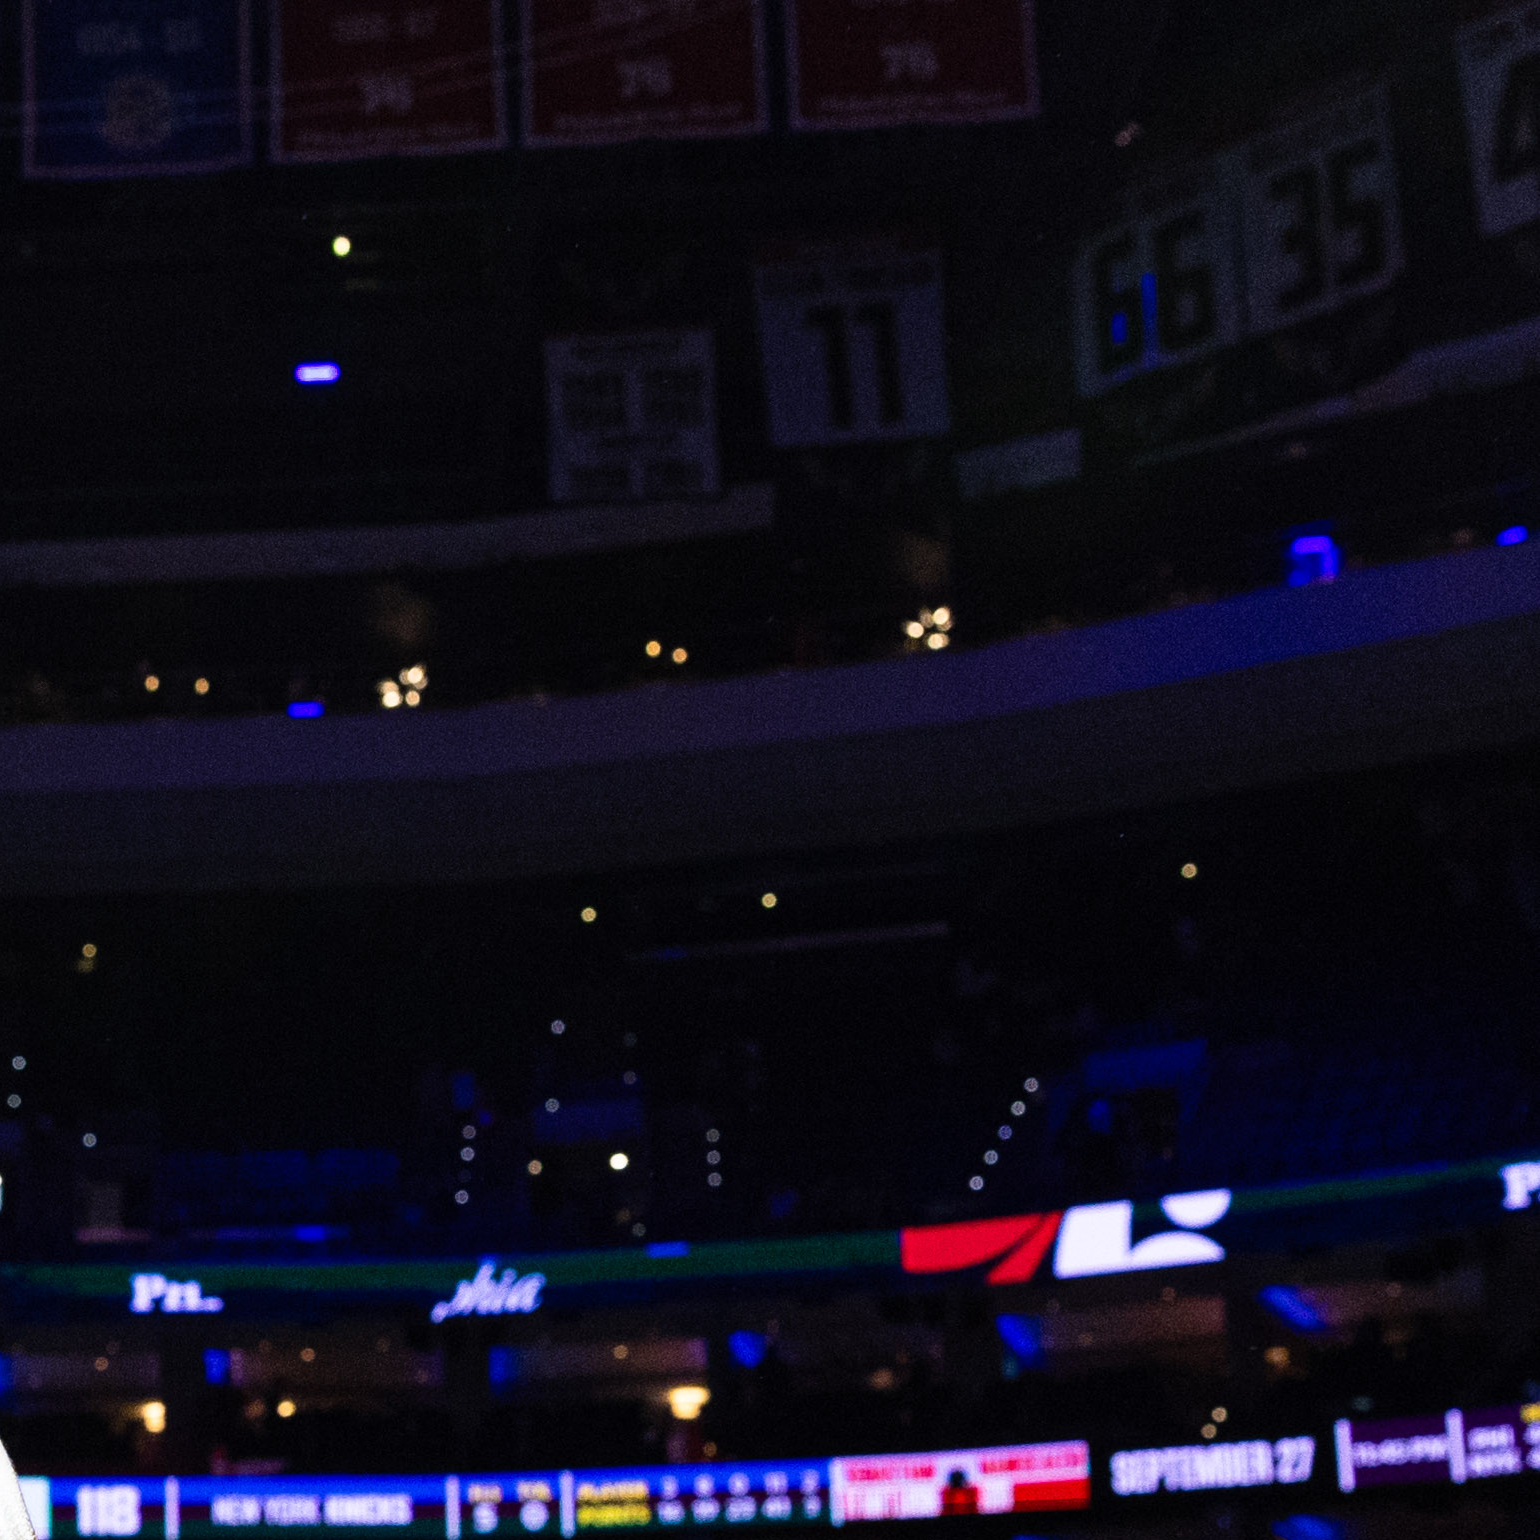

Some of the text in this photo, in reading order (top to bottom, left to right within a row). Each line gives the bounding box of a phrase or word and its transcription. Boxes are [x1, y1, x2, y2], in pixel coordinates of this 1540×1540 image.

[1093, 211, 1217, 377] 66
[1269, 138, 1388, 311] 35
[806, 302, 905, 429] 11
[1112, 1440, 1274, 1495] SEPTEMBER
[1275, 1436, 1315, 1483] 27
